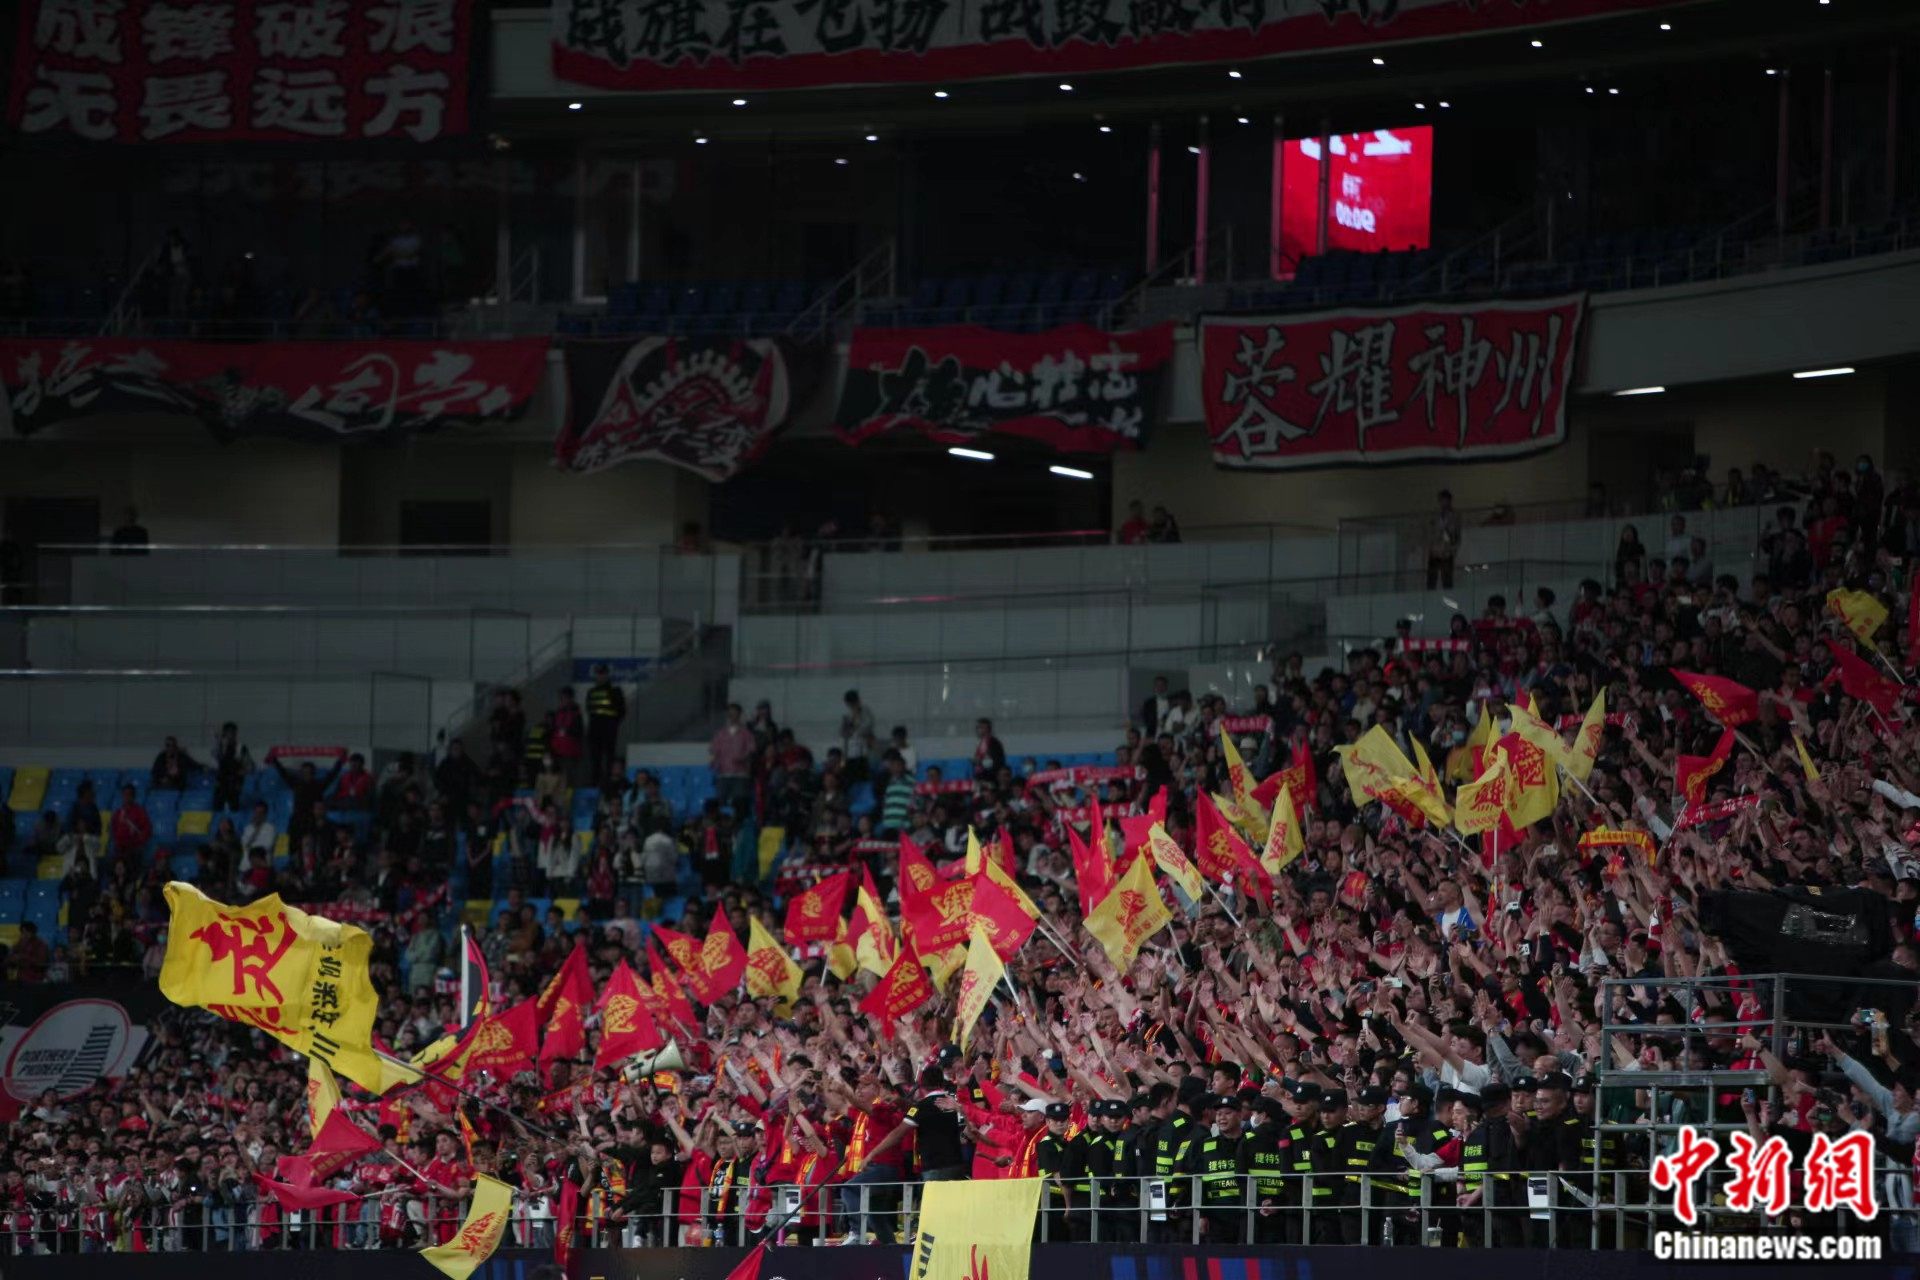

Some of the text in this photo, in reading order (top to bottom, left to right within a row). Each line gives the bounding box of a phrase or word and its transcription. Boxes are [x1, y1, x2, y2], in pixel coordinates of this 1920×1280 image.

[20, 63, 451, 142] 无畏远方
[1213, 312, 1563, 460] 蓉耀神州
